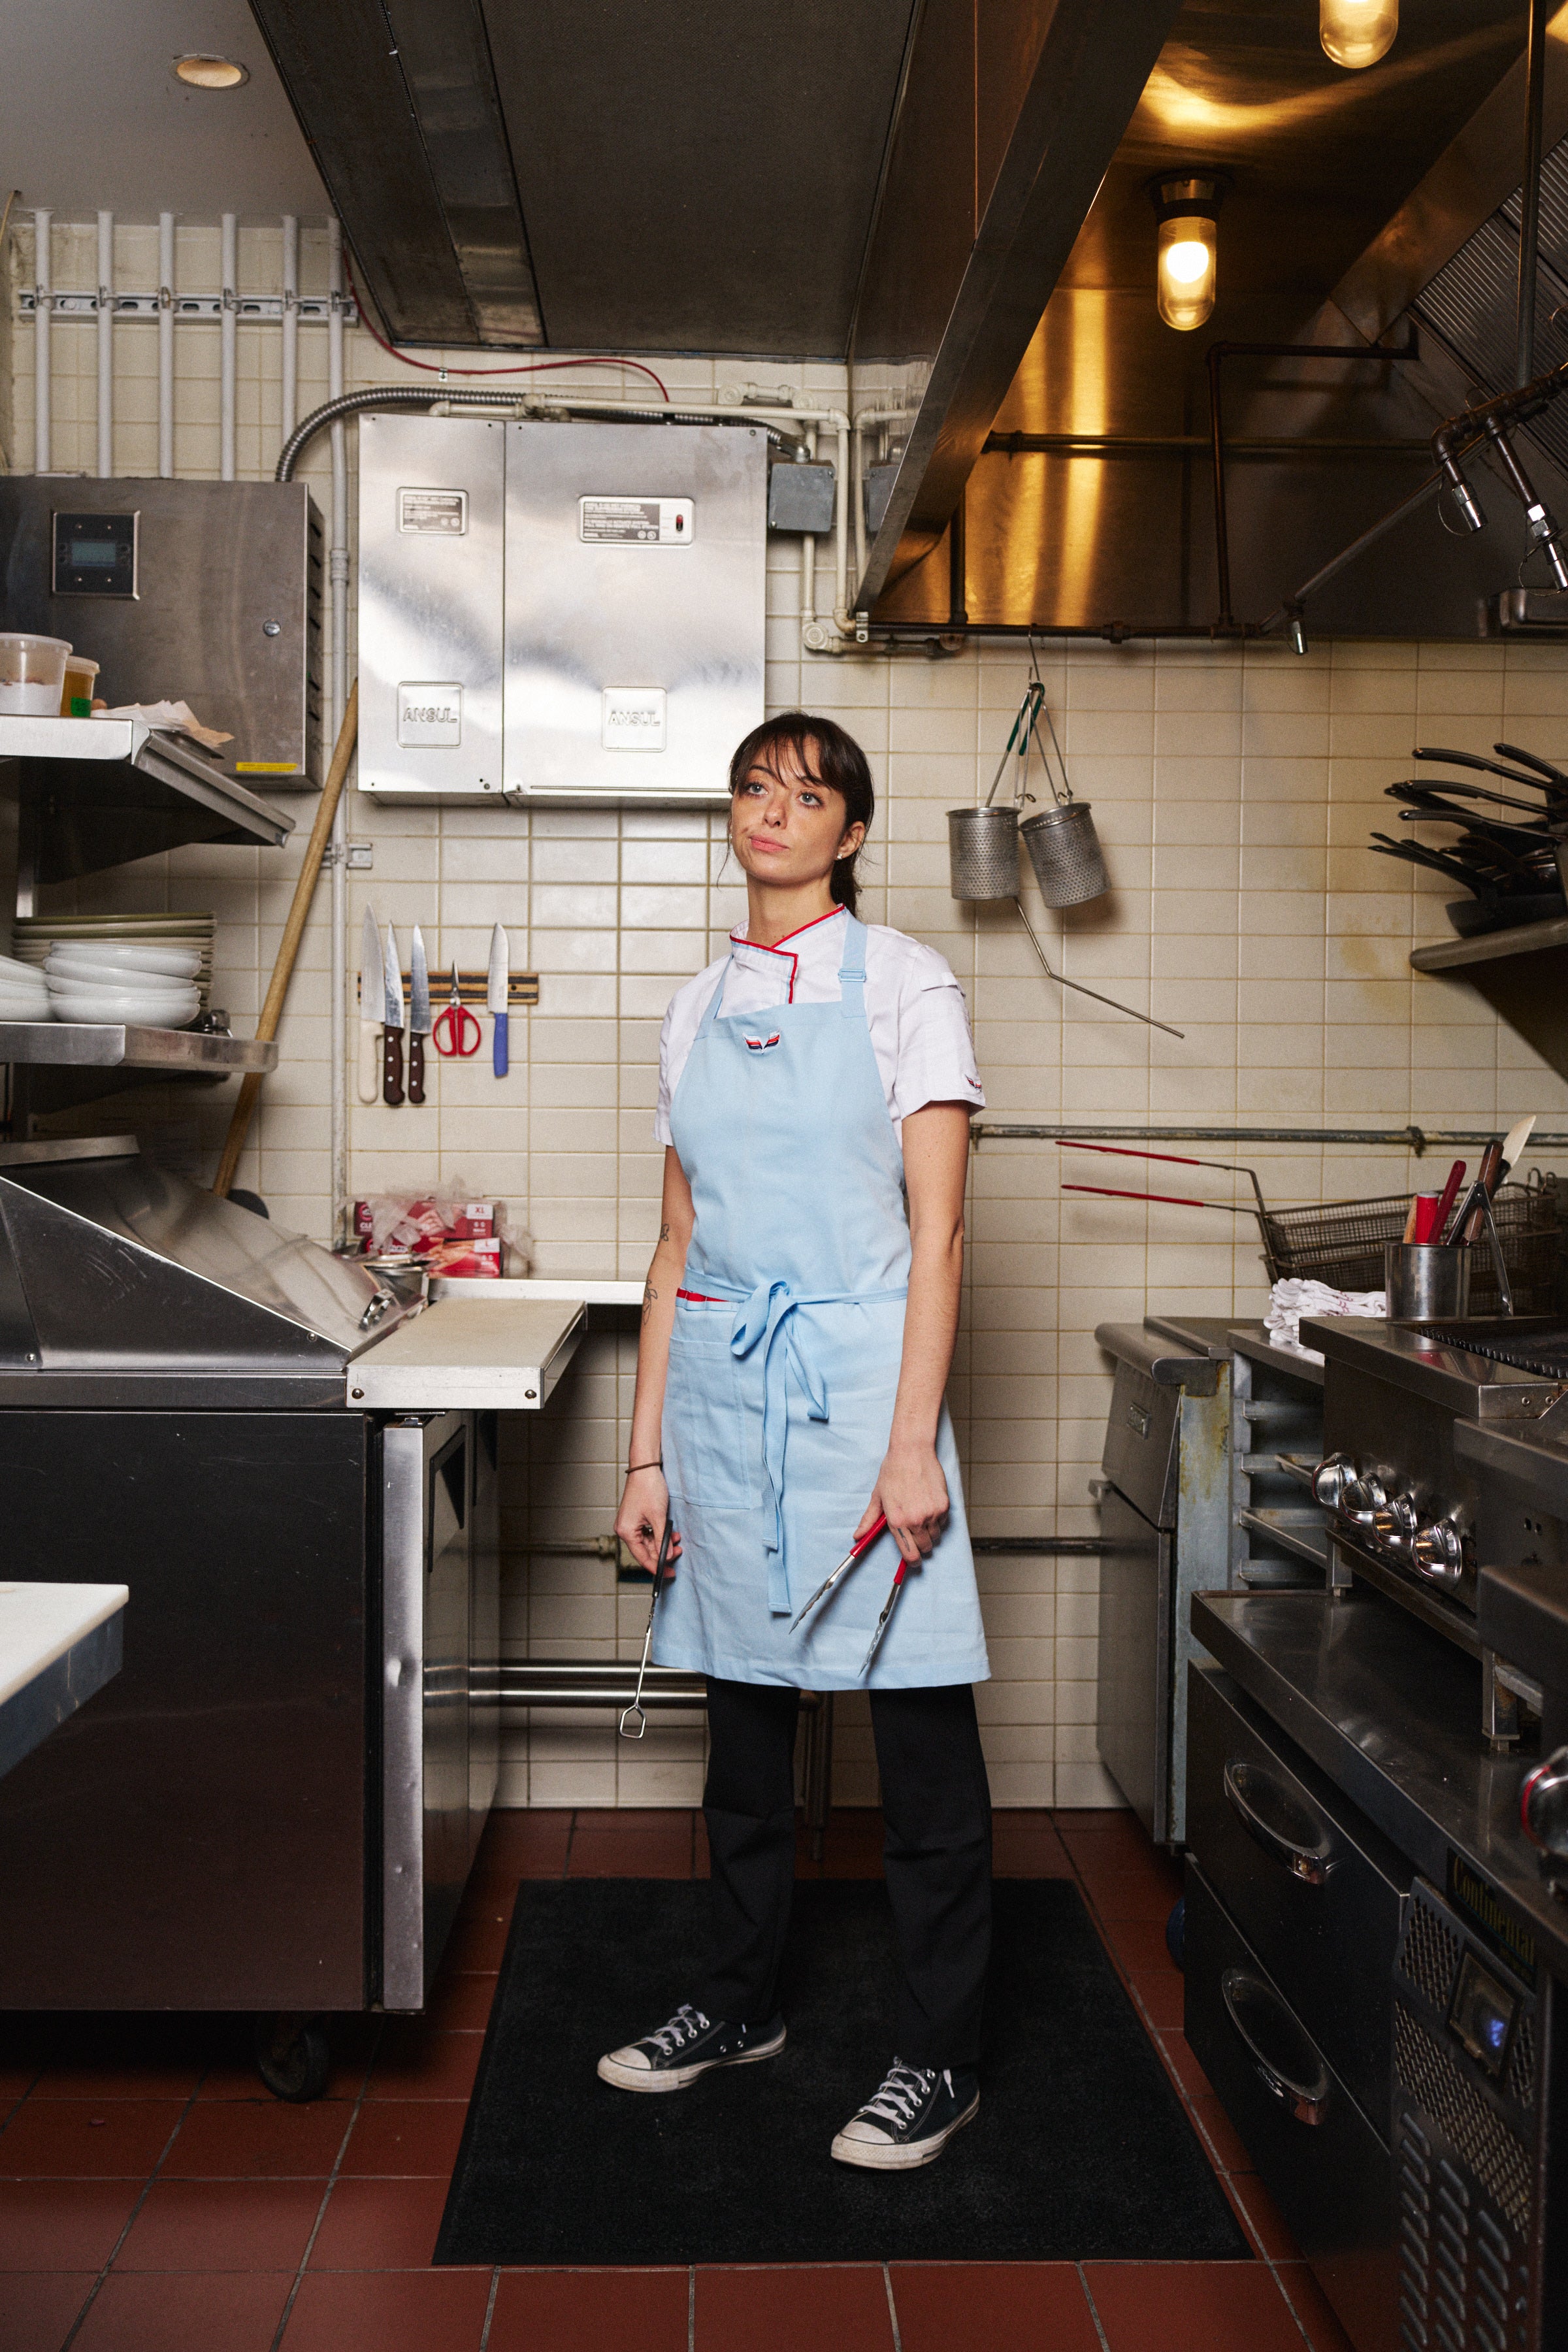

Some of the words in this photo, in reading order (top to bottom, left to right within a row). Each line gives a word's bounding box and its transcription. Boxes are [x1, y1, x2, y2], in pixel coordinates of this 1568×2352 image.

[403, 708, 457, 723] ANSUL
[608, 709, 661, 727] ANSUL
[1454, 1855, 1535, 1967] Continental
